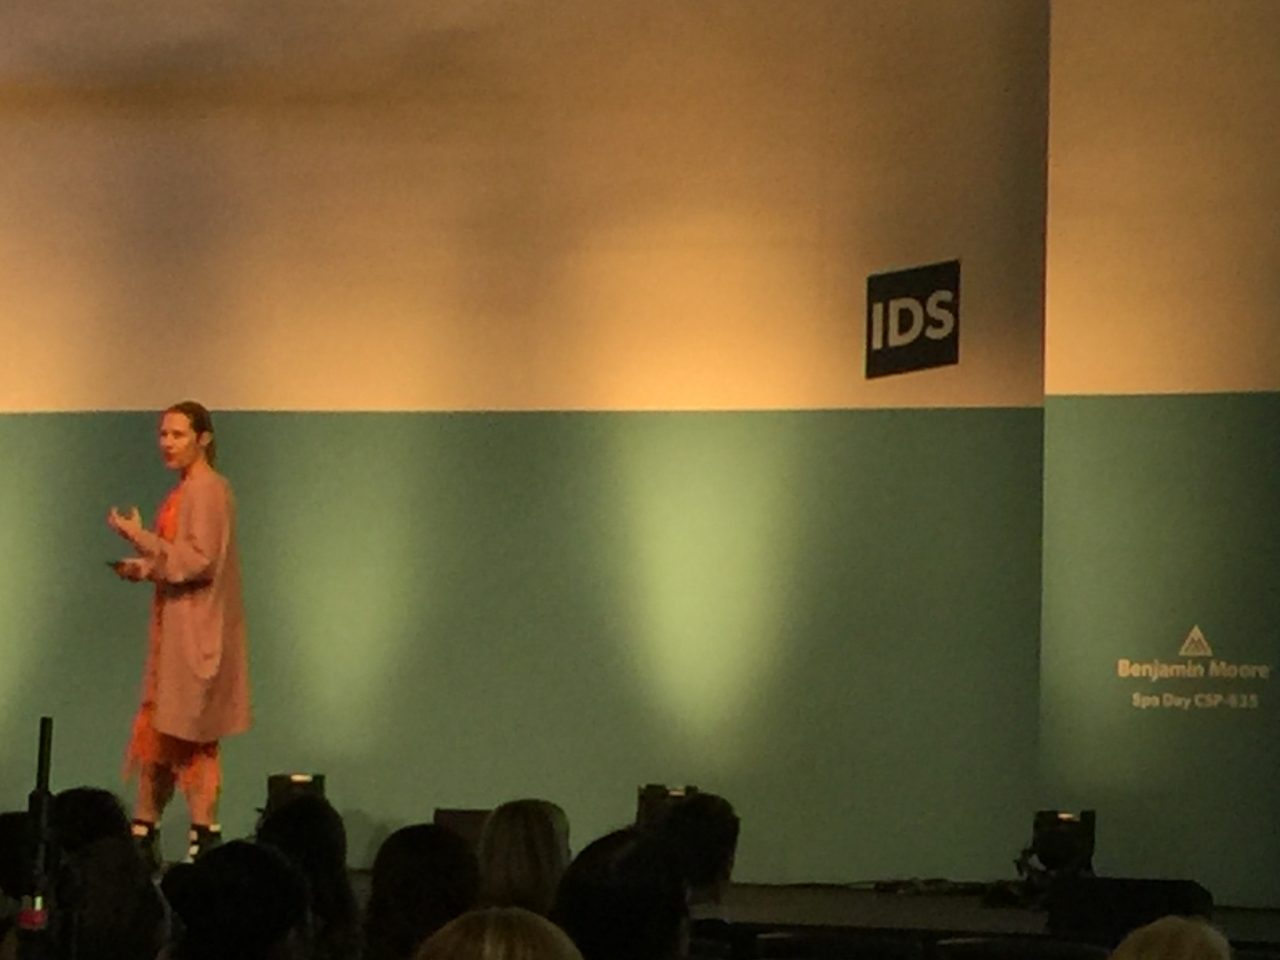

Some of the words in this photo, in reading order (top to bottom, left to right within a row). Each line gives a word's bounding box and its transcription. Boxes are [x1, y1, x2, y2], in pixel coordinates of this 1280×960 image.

[871, 289, 955, 350] IDS
[1116, 659, 1205, 682] Benjamin
[1208, 659, 1271, 679] Moore
[1162, 692, 1192, 710] Day
